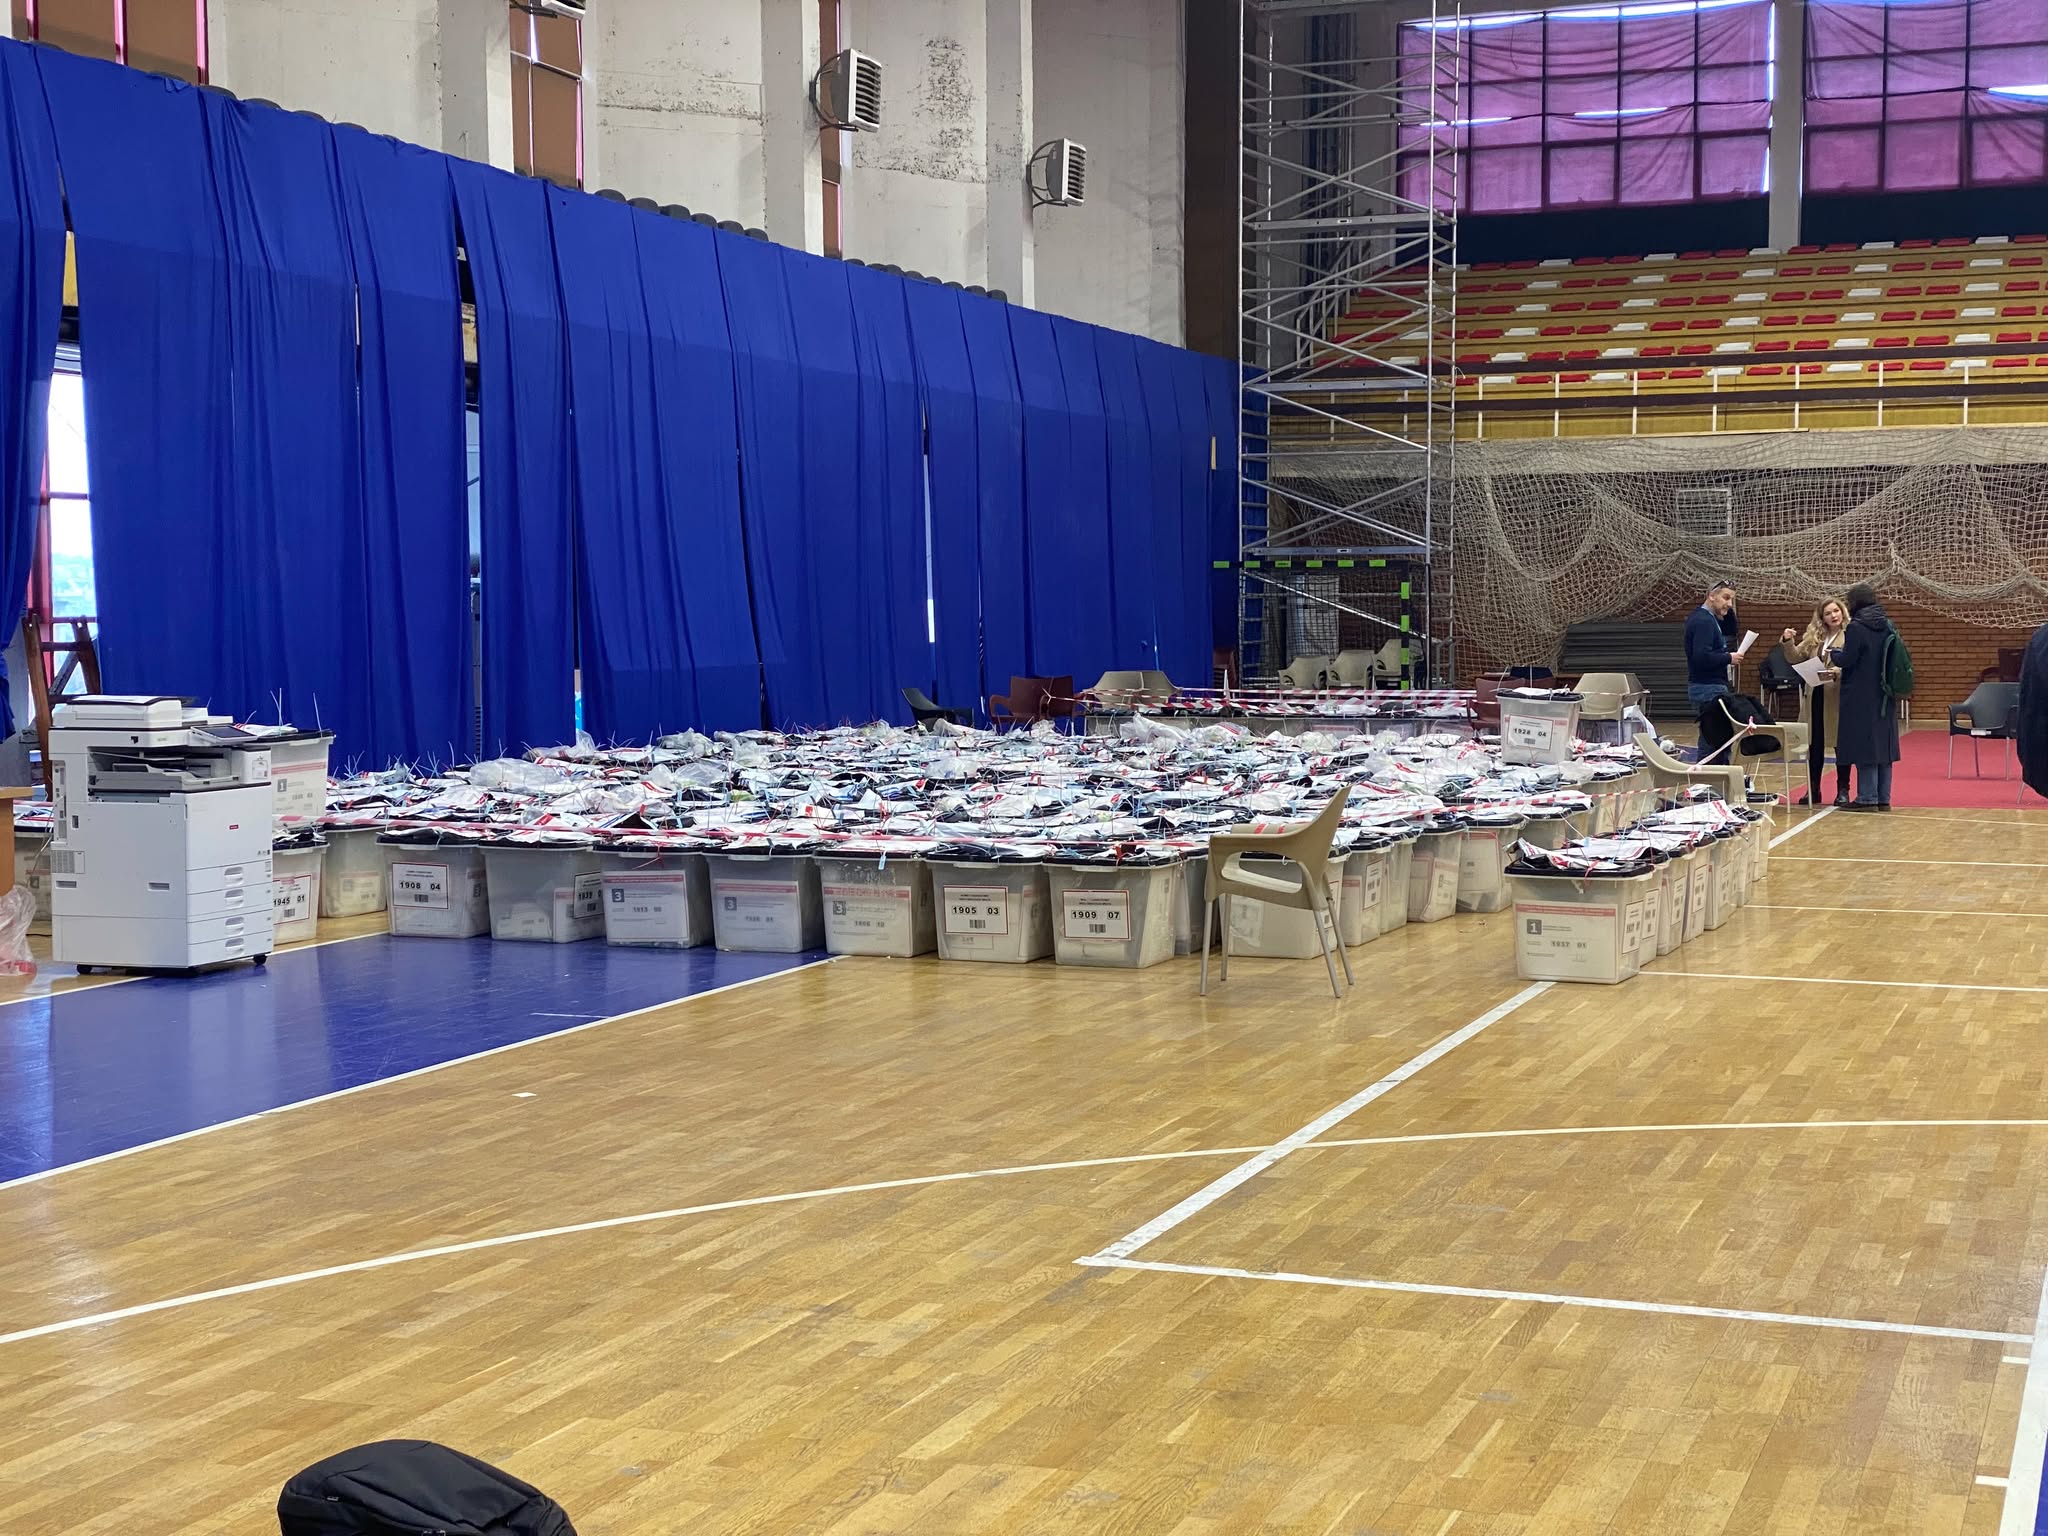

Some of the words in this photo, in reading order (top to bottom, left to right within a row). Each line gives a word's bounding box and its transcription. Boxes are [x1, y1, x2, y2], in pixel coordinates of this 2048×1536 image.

[273, 897, 291, 906] 1945
[296, 894, 305, 902] 01
[614, 891, 622, 902] 3
[727, 899, 735, 909] 3
[836, 903, 844, 914] 3
[953, 906, 977, 914] 1905
[987, 907, 999, 915] 03
[1072, 911, 1097, 919] 1909
[1108, 911, 1120, 919] 07
[1530, 922, 1538, 933] 1
